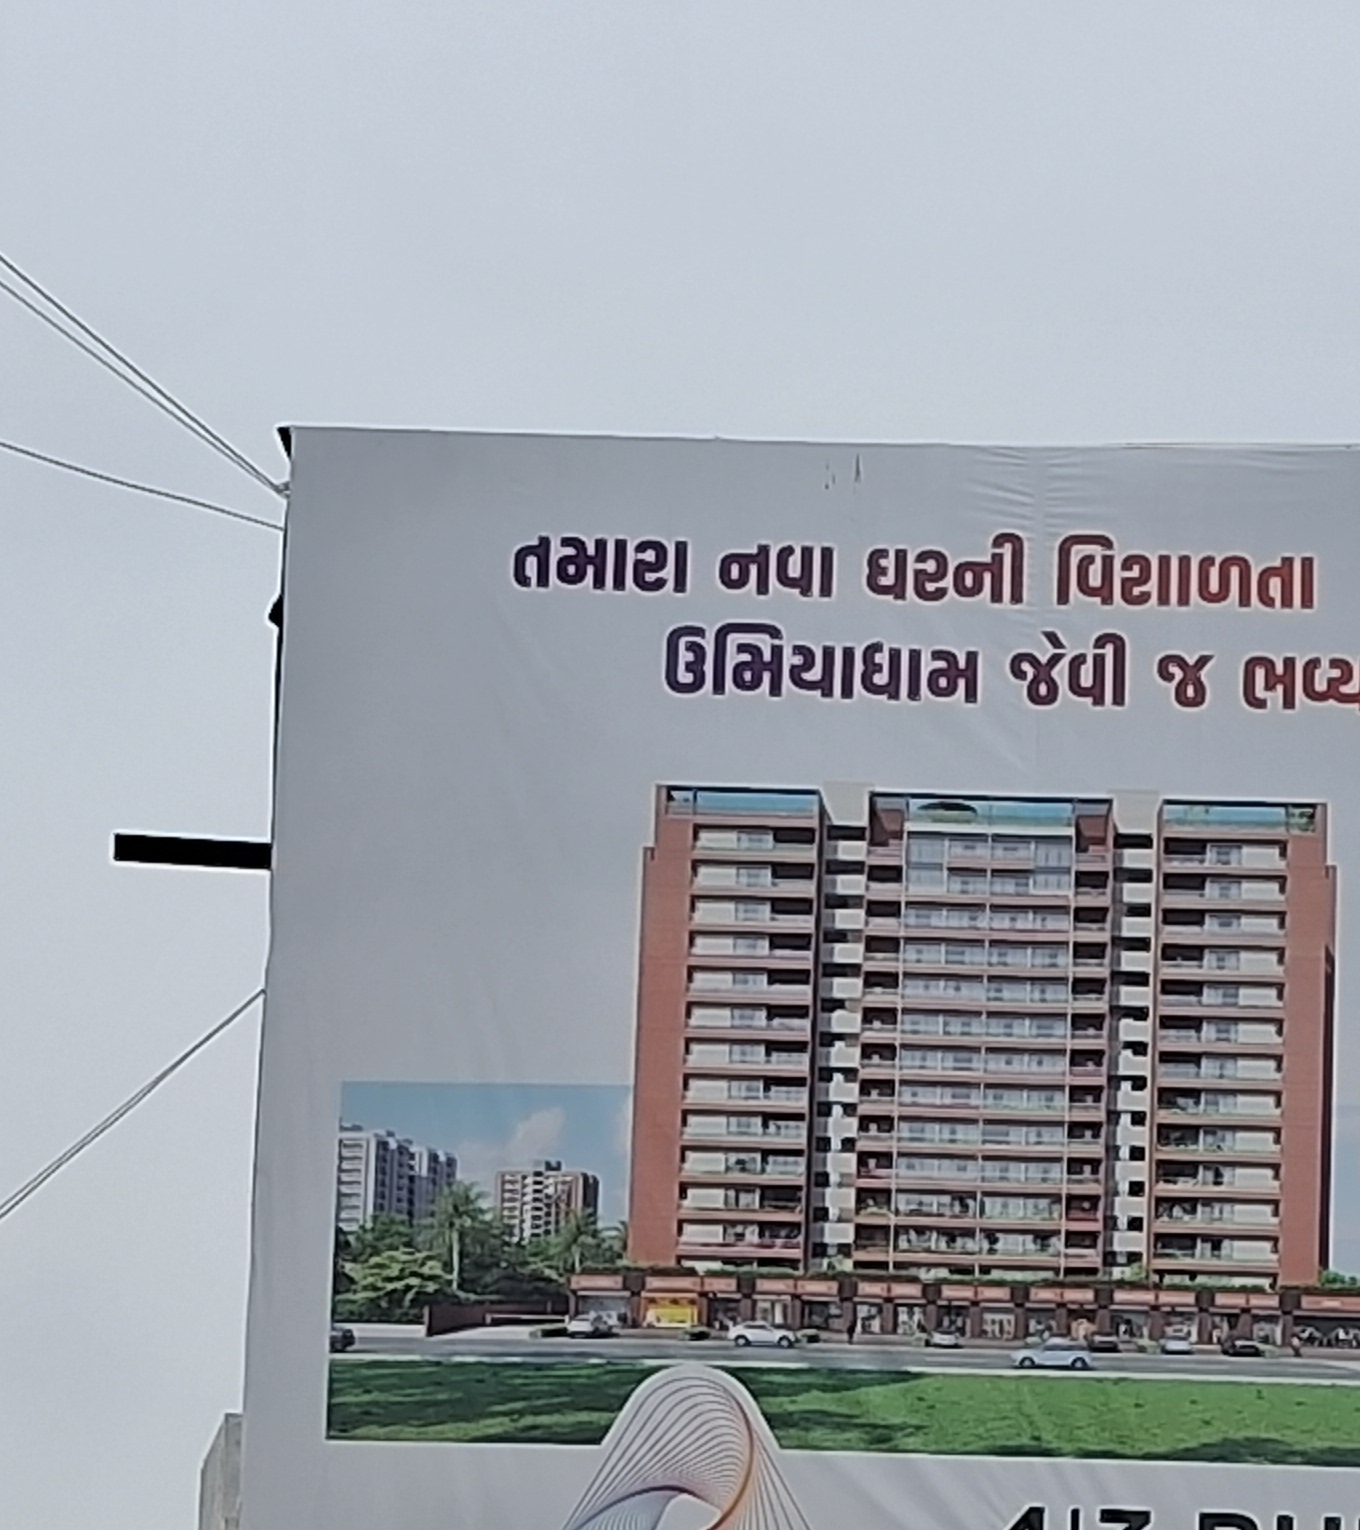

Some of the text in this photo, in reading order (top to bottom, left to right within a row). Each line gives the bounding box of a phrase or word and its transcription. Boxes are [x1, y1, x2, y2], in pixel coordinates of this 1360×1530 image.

[513, 533, 1315, 609] તમારા નવા ઘરની વિશાળતા
[665, 622, 980, 704] ઉમિયાધામ
[1010, 630, 1125, 707] જેવી
[1157, 653, 1215, 708] જ
